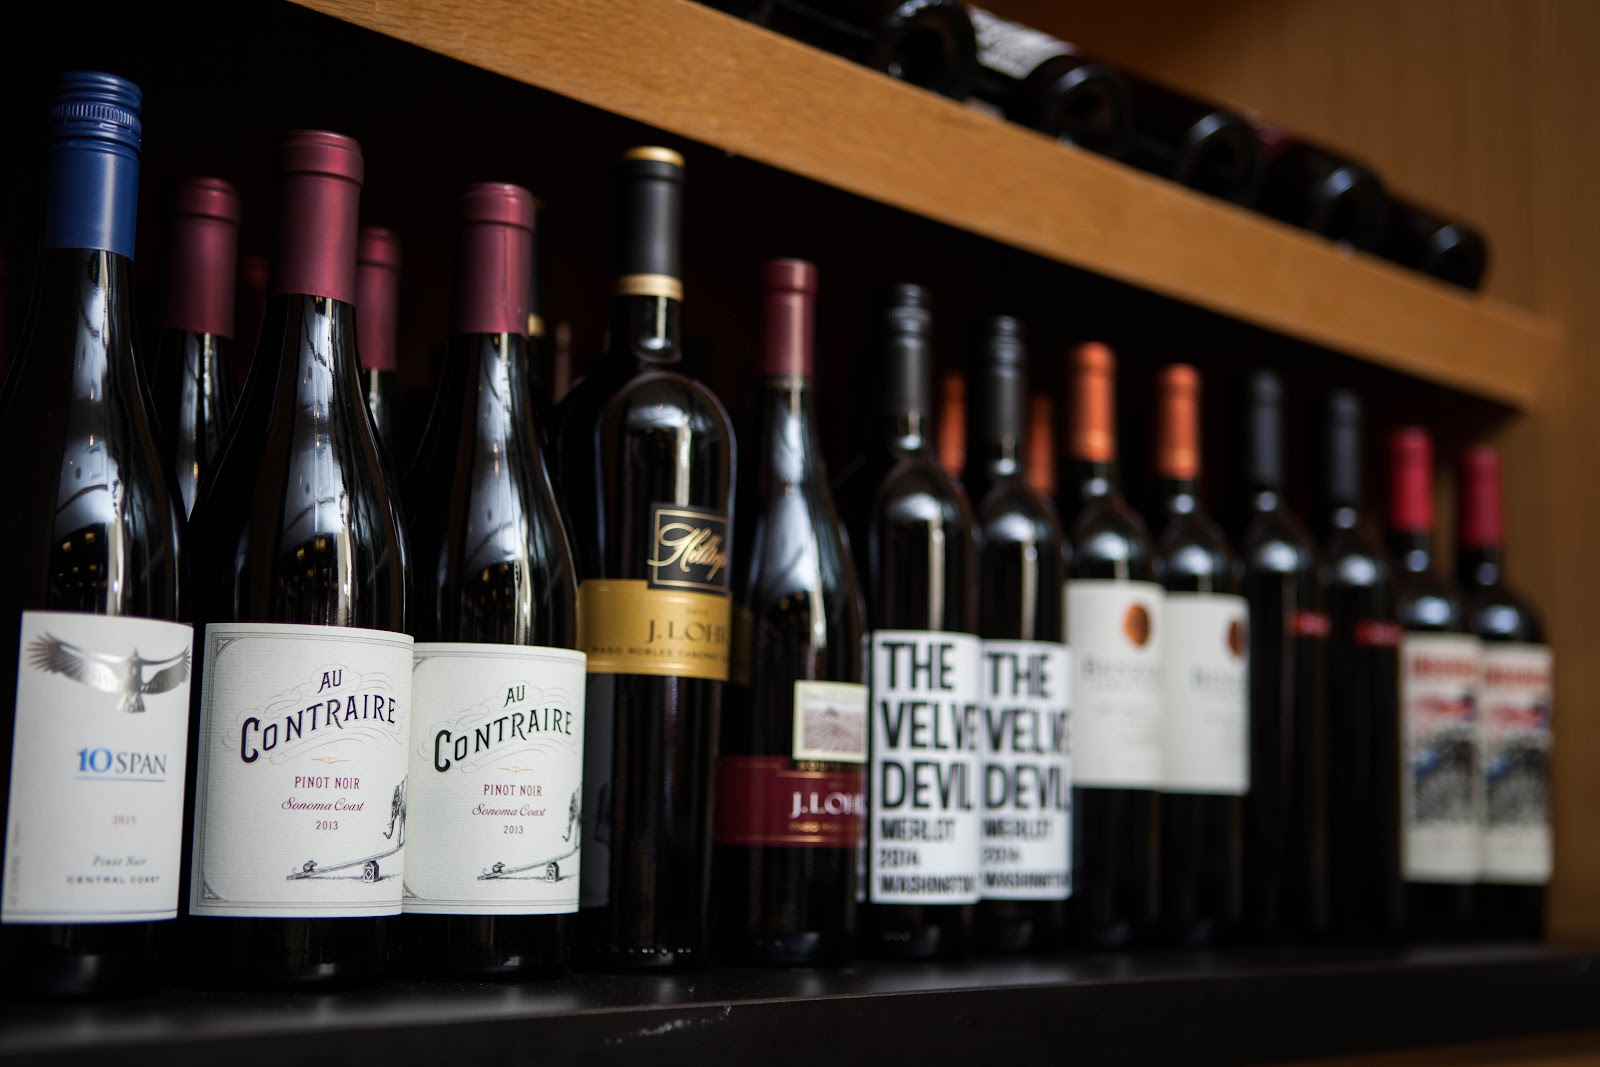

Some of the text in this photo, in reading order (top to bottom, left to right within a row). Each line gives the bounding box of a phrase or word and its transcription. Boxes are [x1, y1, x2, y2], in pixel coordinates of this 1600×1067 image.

[881, 641, 955, 692] THE
[983, 652, 1051, 698] THE
[317, 669, 343, 694] AU
[503, 684, 526, 709] AU
[240, 694, 396, 764] CONTRAIRE
[434, 708, 573, 773] CONTRAIRE
[294, 776, 360, 790] PINOT NOIR
[483, 784, 543, 797] PINOT NOIR
[881, 759, 974, 812] DEVIL
[281, 797, 365, 812] Sonoma Coast
[471, 803, 547, 817] Sonoma Coast
[112, 815, 137, 826] 2015
[315, 820, 339, 831] 2013
[503, 825, 524, 835] 2013
[881, 817, 955, 842] MERLOT
[983, 817, 1053, 841] MERLOT
[92, 855, 148, 867] Pinot Noir
[66, 875, 161, 885] CENTRAL COAST
